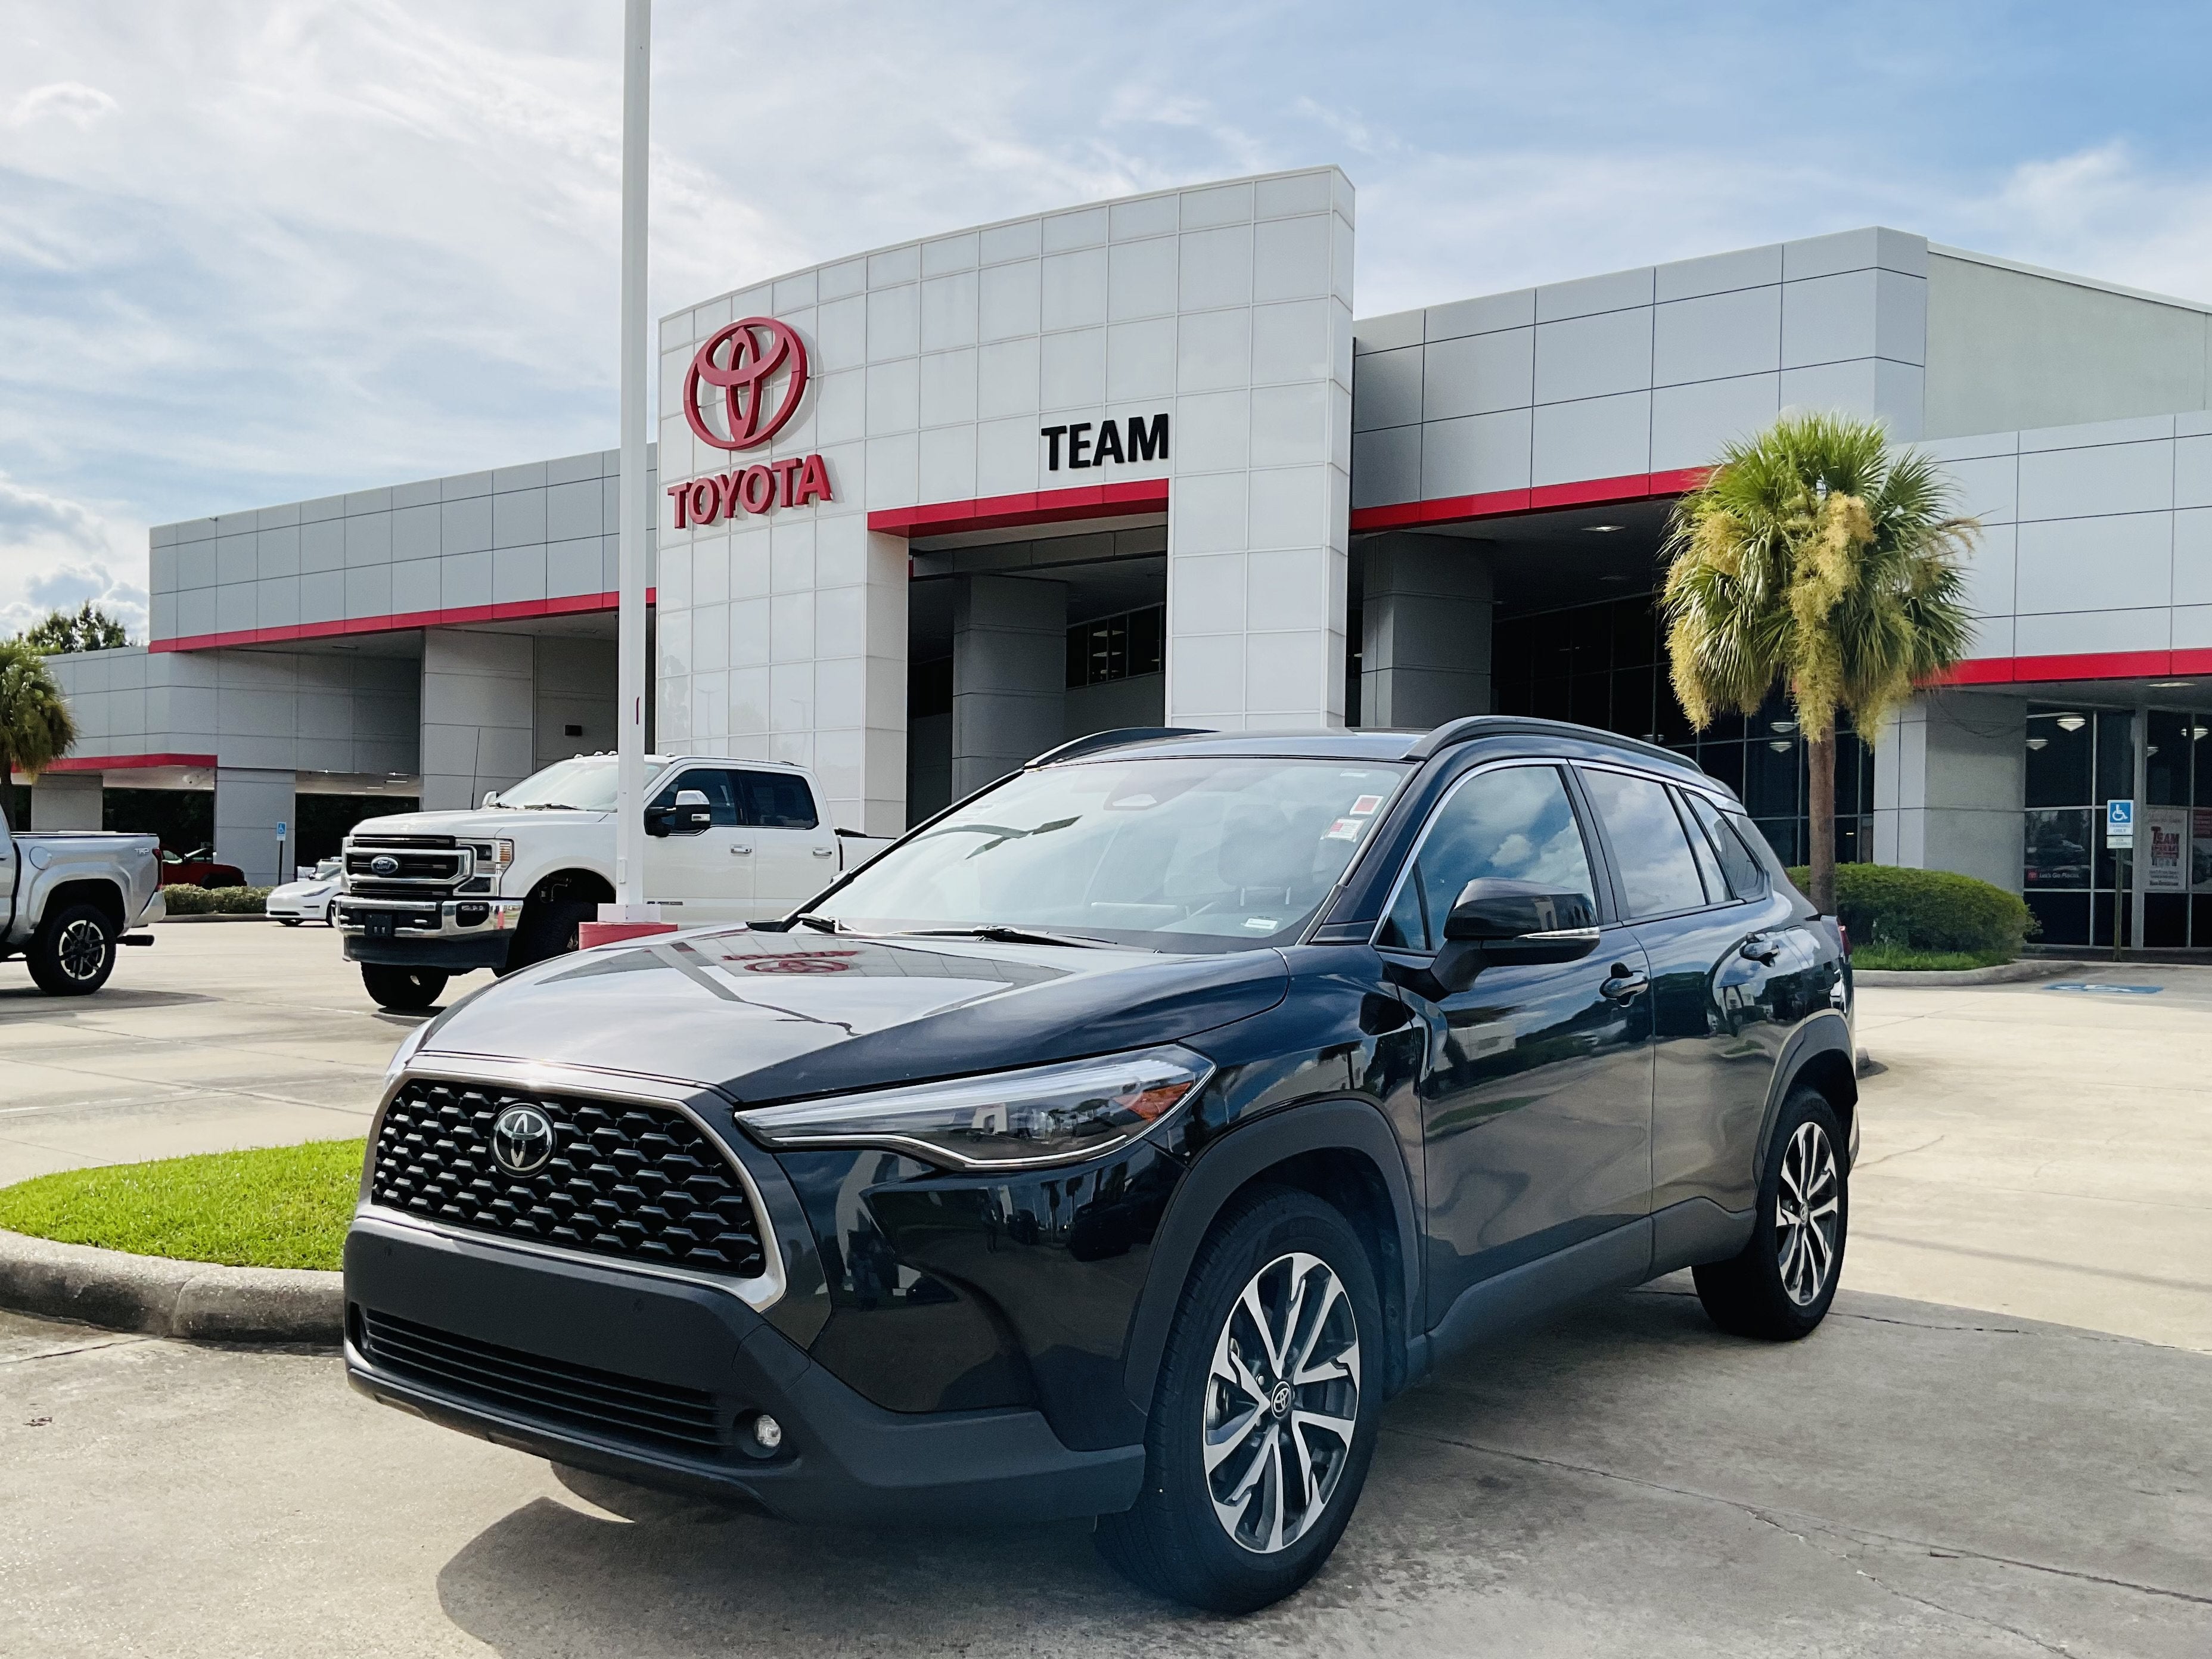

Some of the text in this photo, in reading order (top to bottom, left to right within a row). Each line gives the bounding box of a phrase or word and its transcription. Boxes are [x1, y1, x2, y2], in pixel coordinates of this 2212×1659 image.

[1041, 414, 1169, 470] TEAM
[667, 454, 833, 529] TOYOTA
[376, 860, 392, 869] Ford
